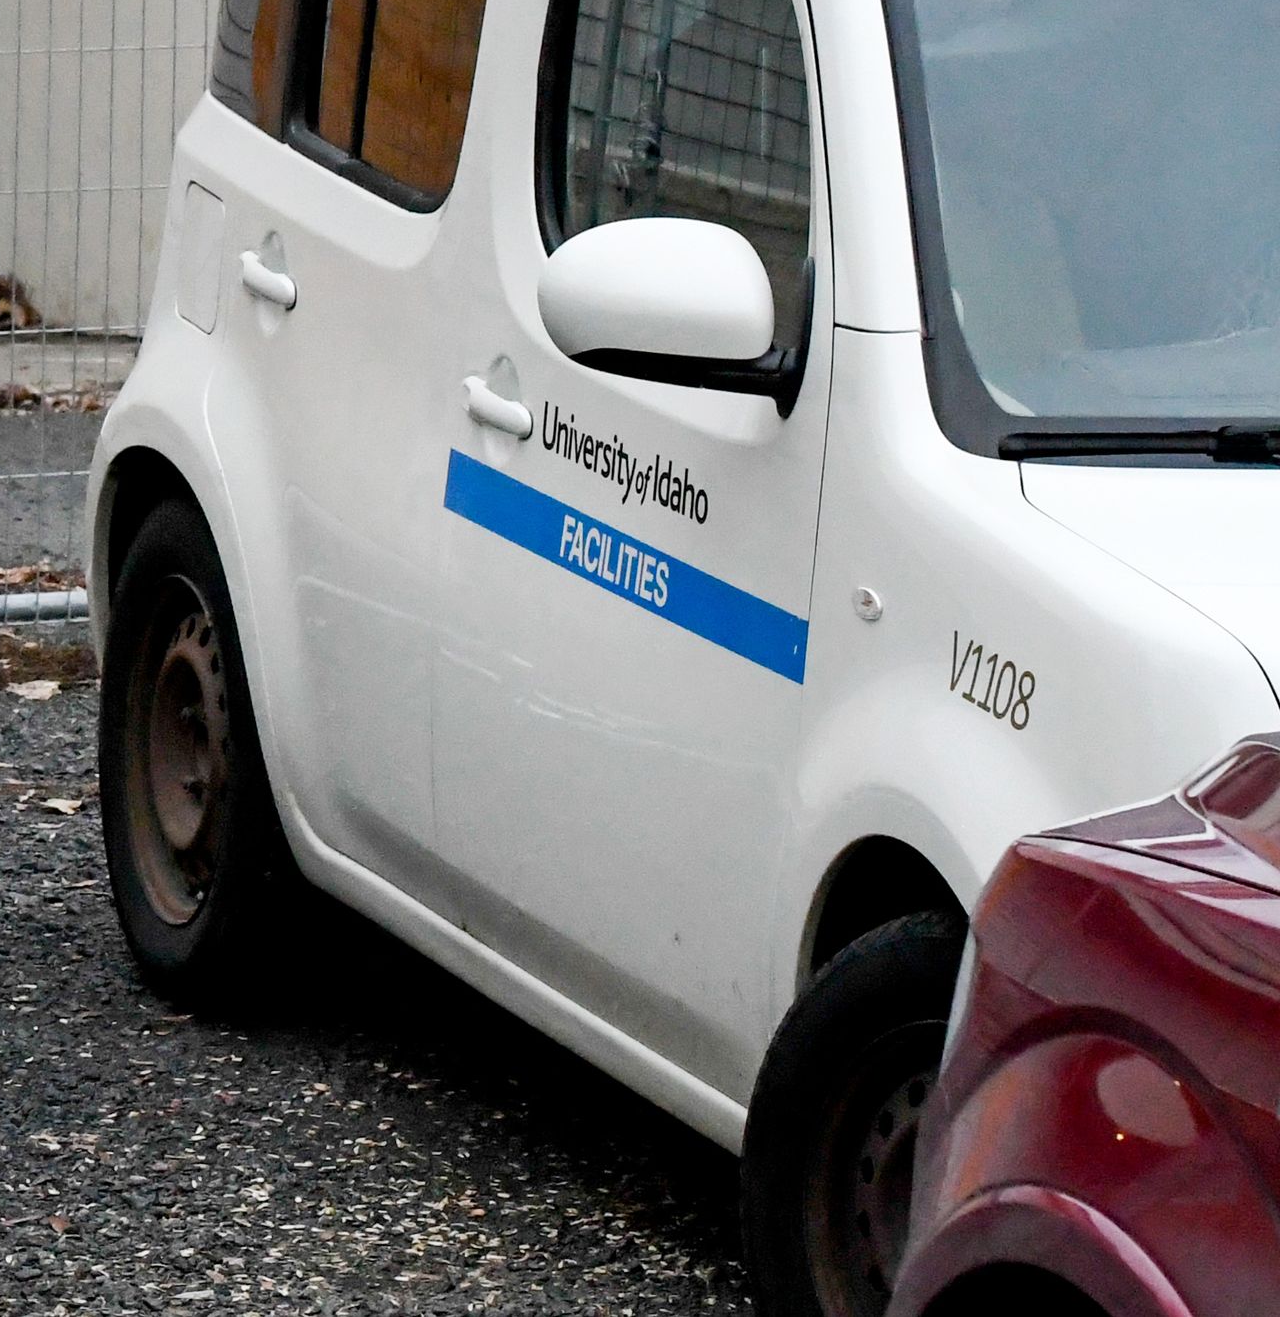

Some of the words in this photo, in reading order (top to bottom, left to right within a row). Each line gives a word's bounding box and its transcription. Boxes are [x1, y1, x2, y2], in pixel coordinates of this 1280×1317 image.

[542, 401, 637, 505] University
[635, 465, 653, 506] of
[652, 454, 708, 524] Idaho
[559, 514, 670, 608] FACILITIES
[949, 630, 1036, 731] V1108
